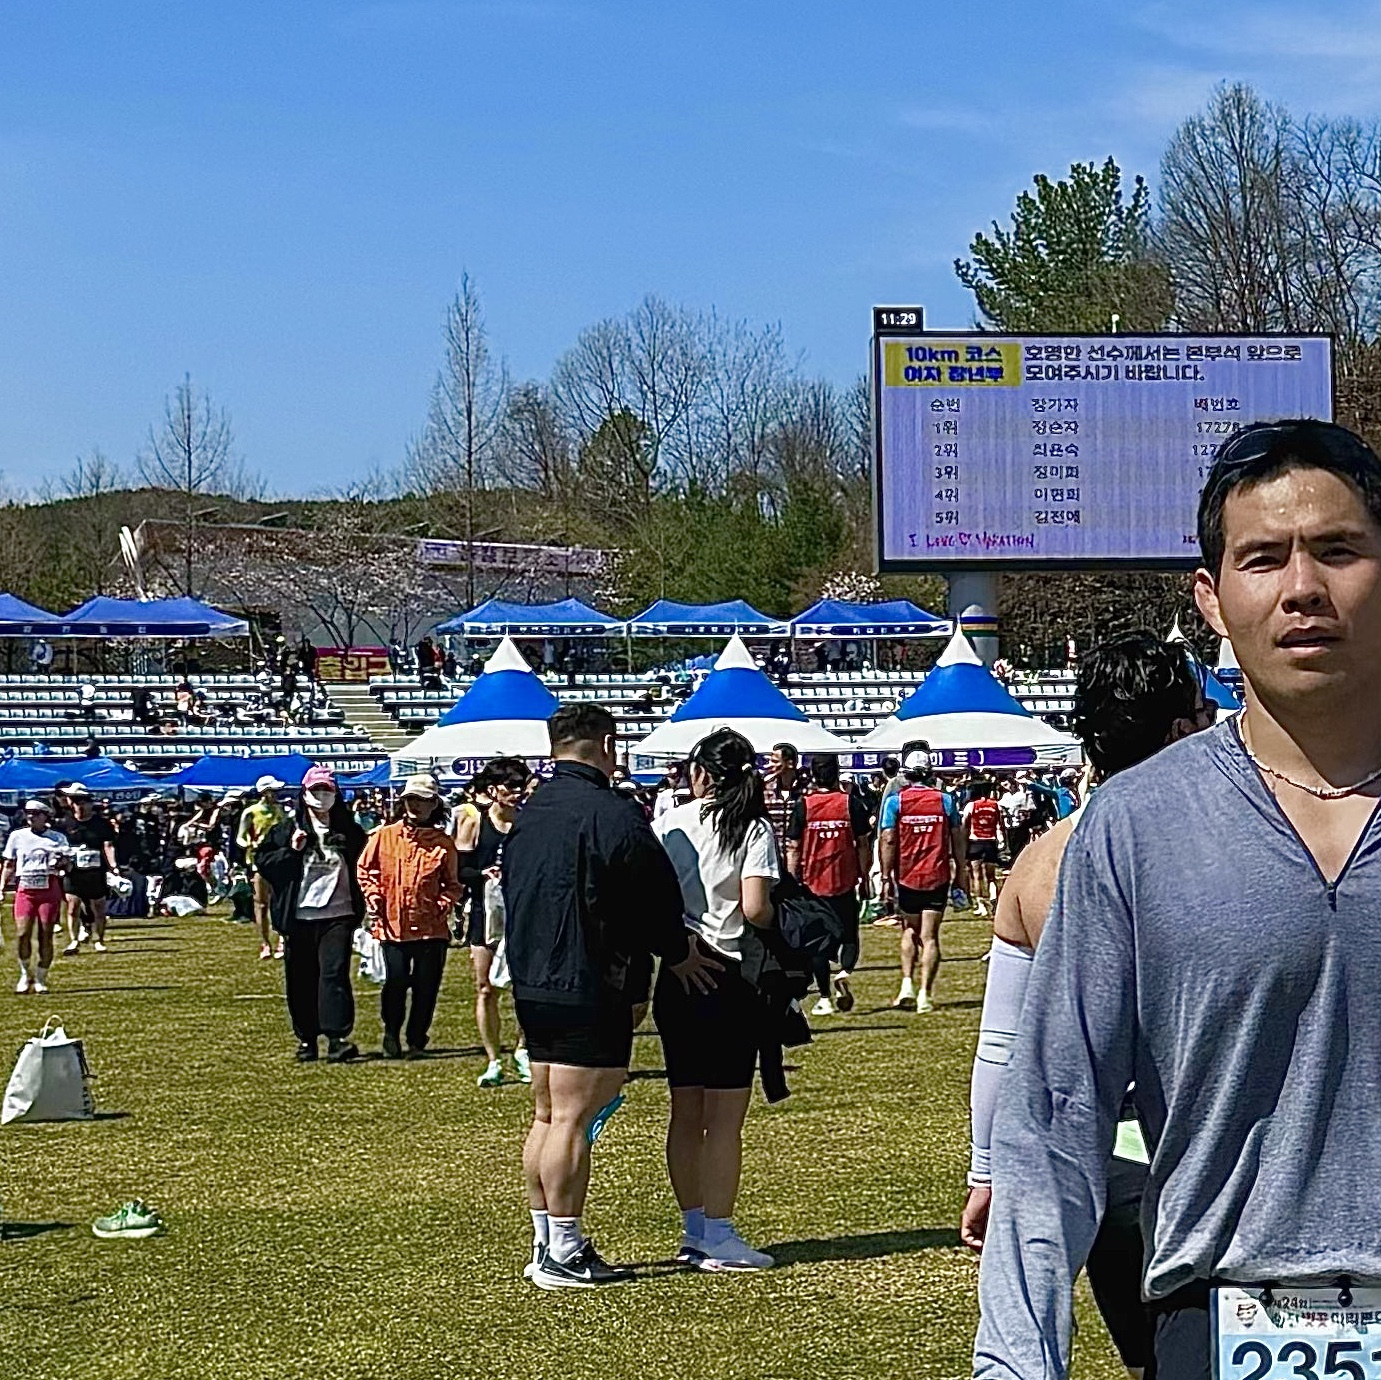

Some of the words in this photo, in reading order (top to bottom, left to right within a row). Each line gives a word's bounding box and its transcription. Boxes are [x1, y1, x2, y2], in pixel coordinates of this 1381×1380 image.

[881, 313, 917, 325] 11:29
[905, 346, 960, 362] 10km
[965, 346, 1003, 362] 코스
[1087, 345, 1180, 361] 선수께서는
[1247, 344, 1302, 361] 앞으로
[1025, 365, 1119, 381] 모여주시기
[1125, 365, 1205, 381] 바랍니다.
[930, 399, 960, 413] 순번
[933, 420, 958, 435] 1위
[934, 443, 958, 458] 2위
[934, 465, 959, 480] 3위
[934, 487, 959, 502] 4위
[935, 510, 959, 525] 5위
